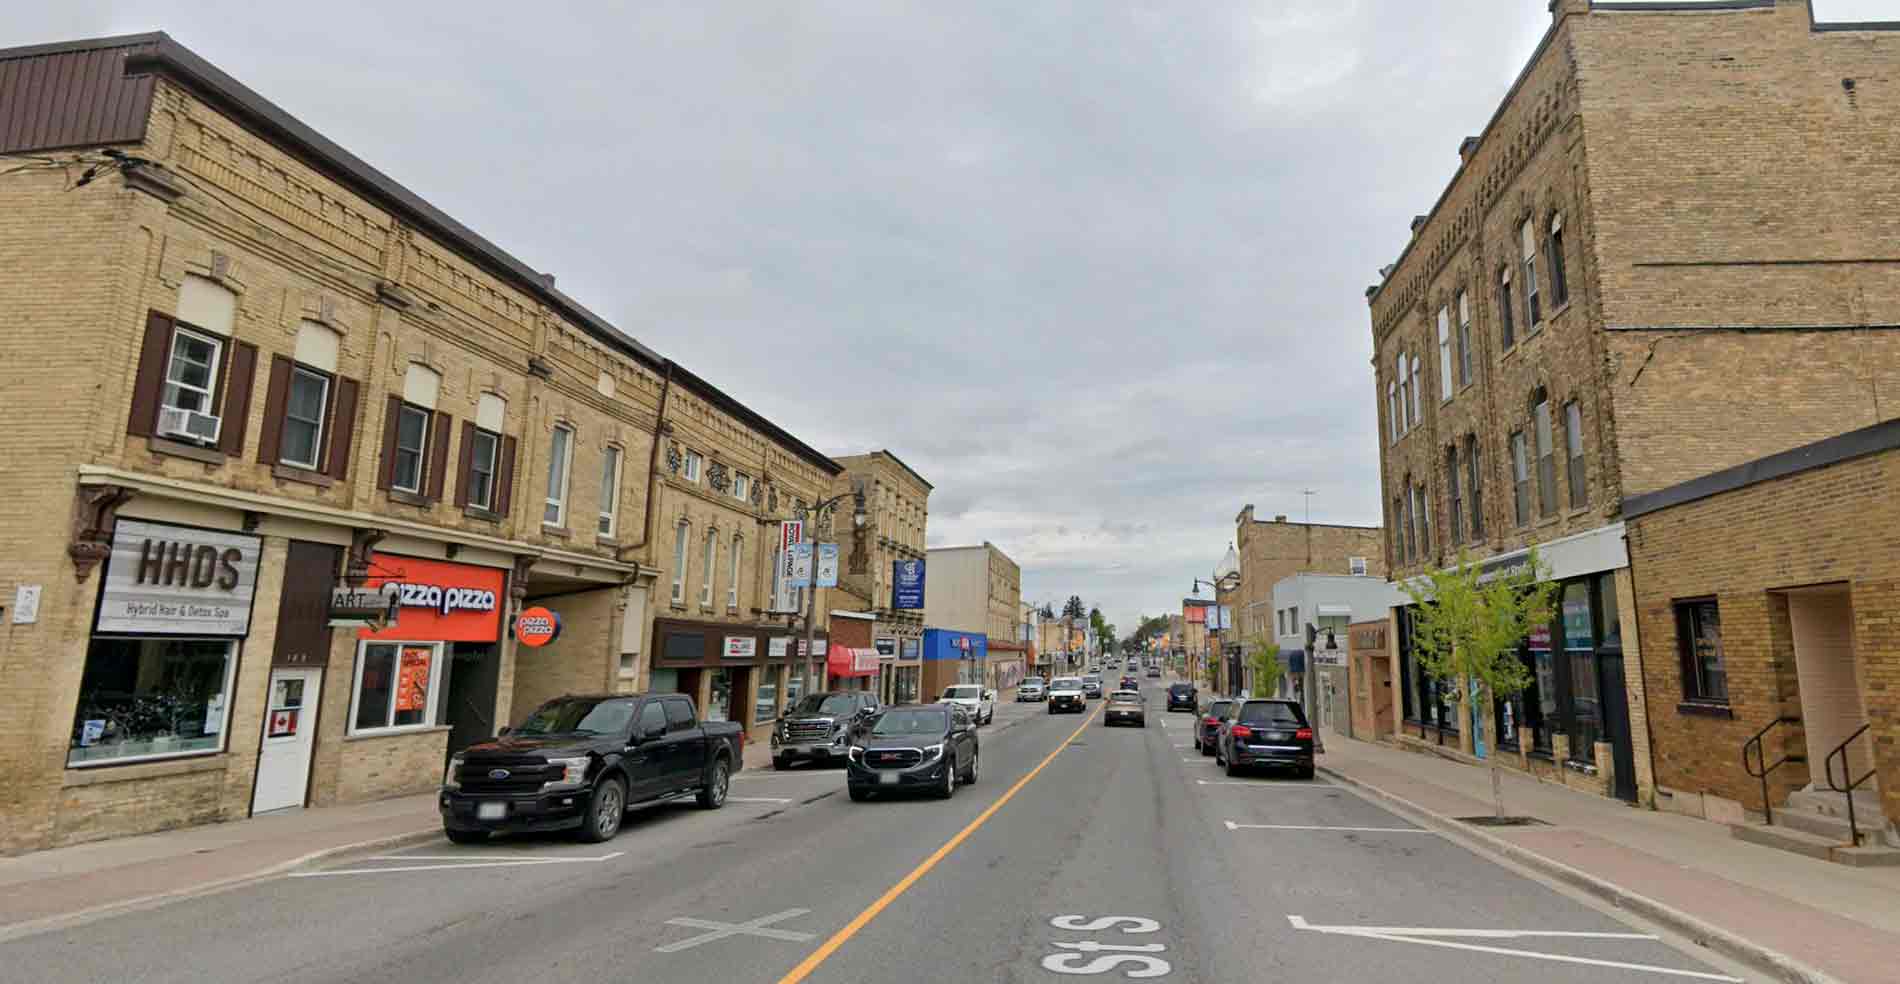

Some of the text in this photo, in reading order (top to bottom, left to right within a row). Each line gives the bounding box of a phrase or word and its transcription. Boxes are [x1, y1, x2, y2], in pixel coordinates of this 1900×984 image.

[136, 538, 243, 591] HHDS
[334, 591, 367, 608] ART
[443, 588, 496, 616] pizza
[126, 600, 230, 620] Hybrid Hair & Detox Spa
[519, 616, 549, 628] pizza
[523, 625, 553, 637] pizza
